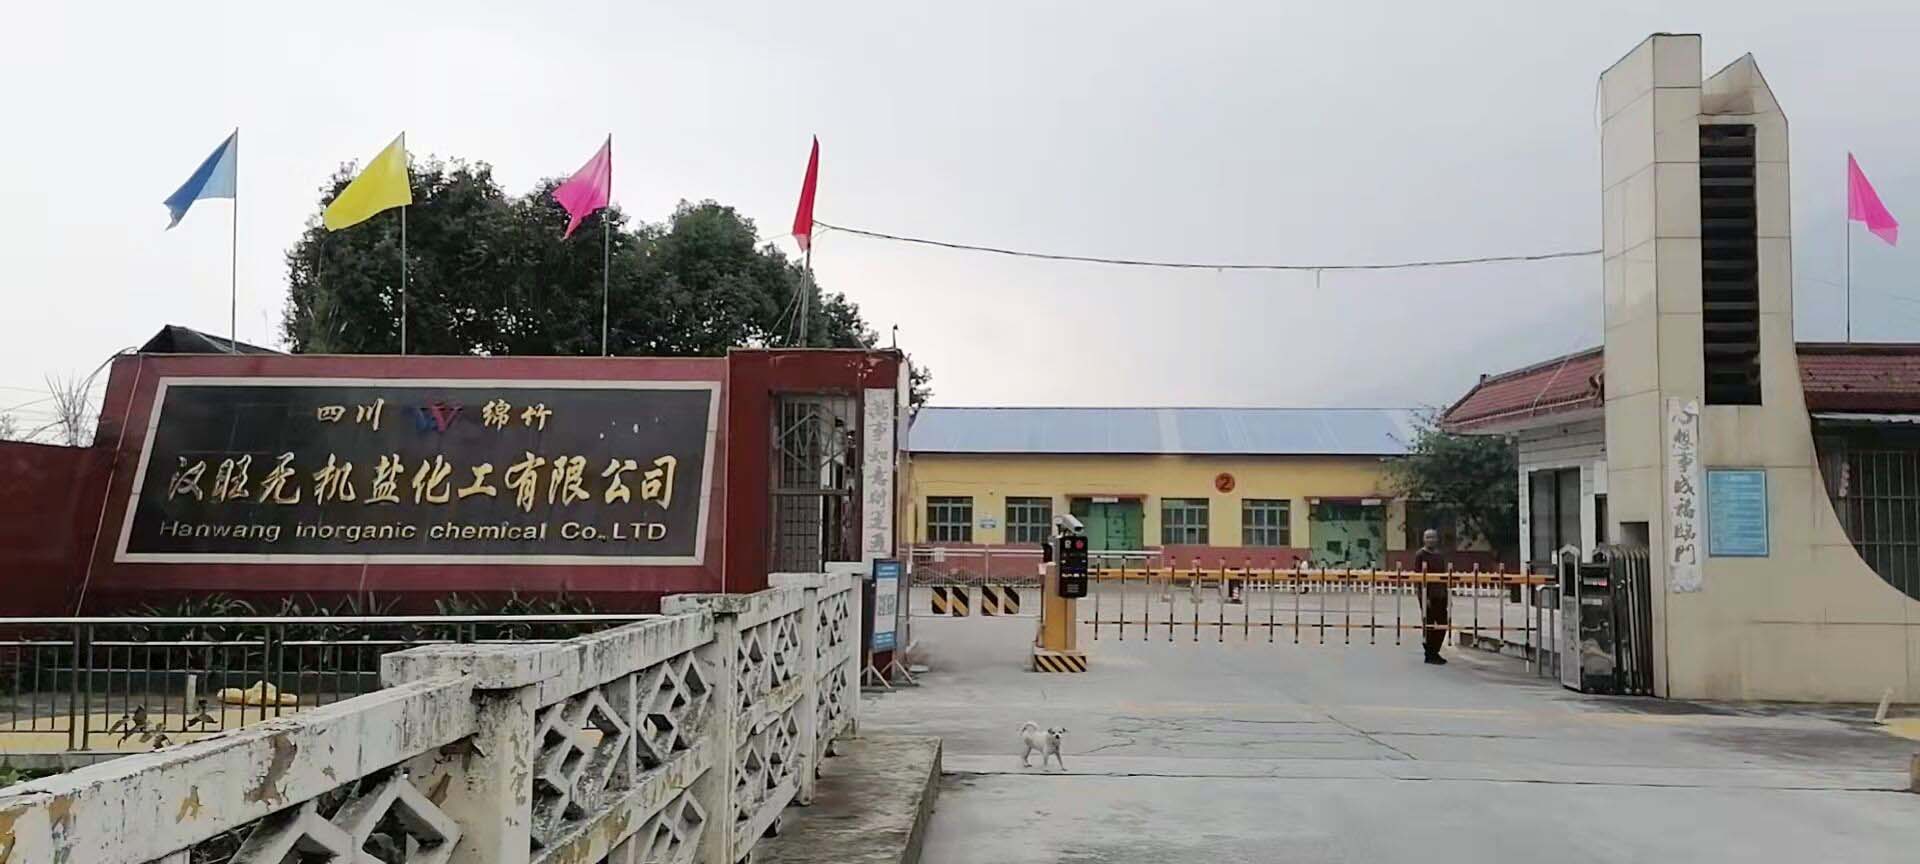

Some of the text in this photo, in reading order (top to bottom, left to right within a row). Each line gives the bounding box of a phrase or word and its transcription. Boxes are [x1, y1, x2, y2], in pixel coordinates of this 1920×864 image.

[317, 398, 384, 431] 四川
[482, 399, 552, 431] 绵竹
[168, 451, 677, 512] 汉旺无机盐化工有限公司
[159, 520, 281, 542] Hanwang
[295, 521, 416, 542] inorganic
[430, 522, 546, 540] chemical
